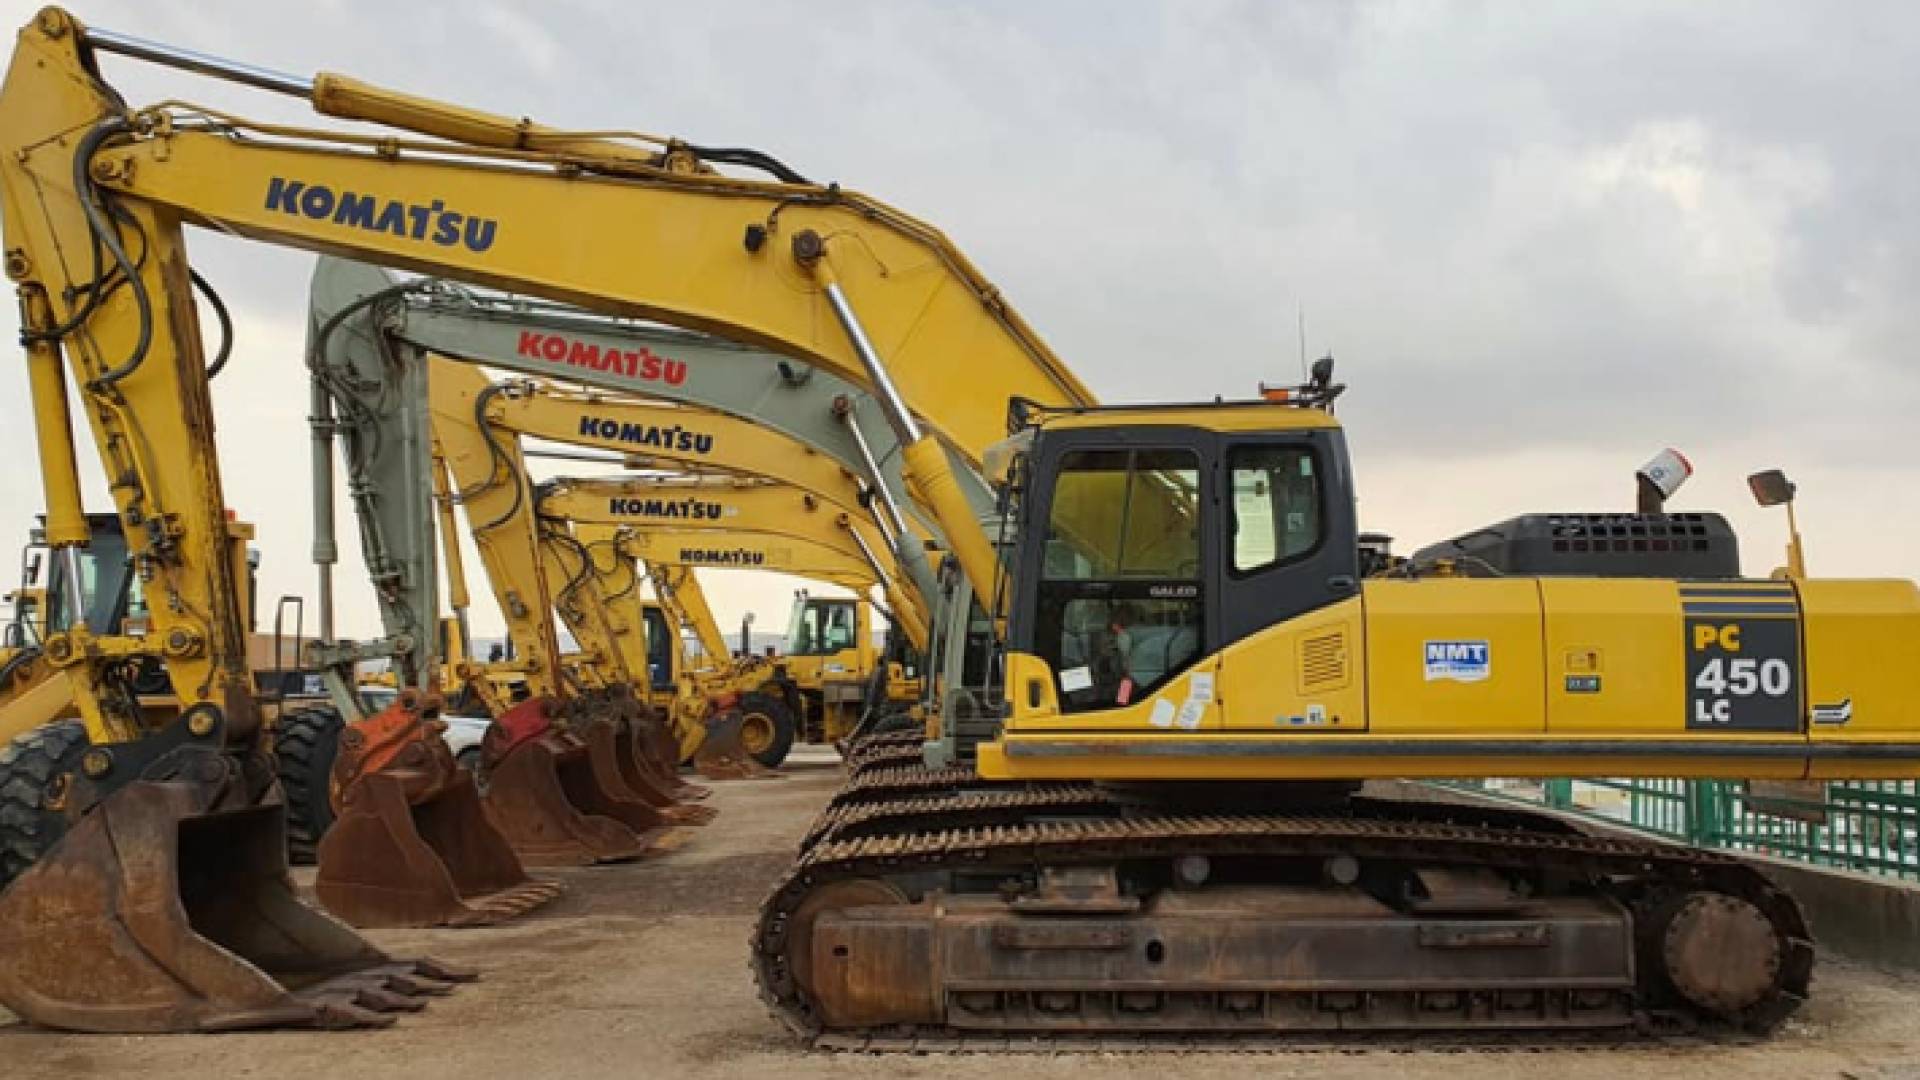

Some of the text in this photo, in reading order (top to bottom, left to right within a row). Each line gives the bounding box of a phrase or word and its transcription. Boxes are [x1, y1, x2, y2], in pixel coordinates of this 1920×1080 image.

[265, 177, 498, 252] KOMATSU
[517, 331, 688, 386] KOMATSU
[578, 416, 713, 453] KOMATSU
[609, 497, 722, 519] KOMATSU
[1693, 624, 1740, 651] PC
[1695, 658, 1791, 696] 450
[1695, 699, 1731, 722] LC
